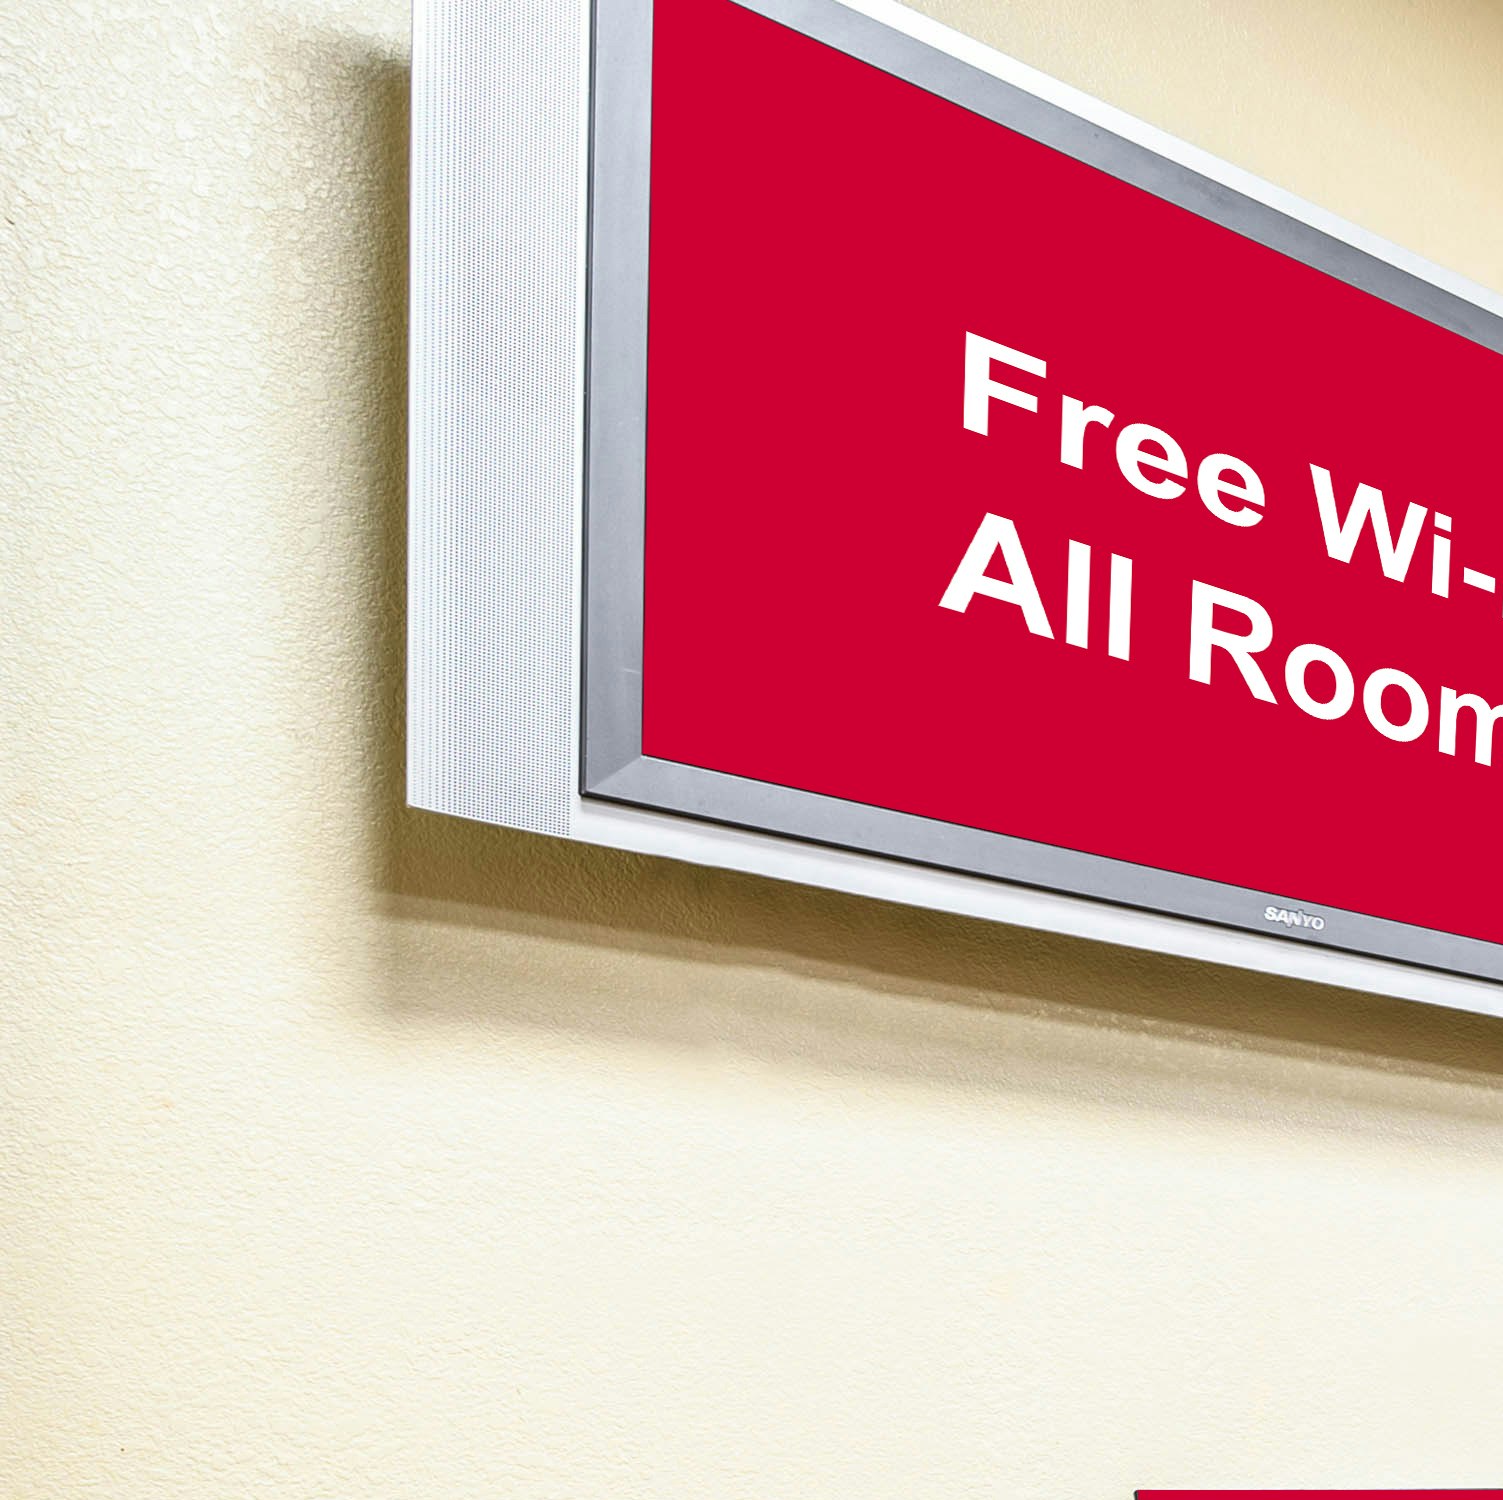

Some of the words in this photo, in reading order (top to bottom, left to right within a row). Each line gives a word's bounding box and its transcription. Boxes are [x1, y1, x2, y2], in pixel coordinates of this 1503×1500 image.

[963, 330, 1266, 529] Free
[937, 512, 1133, 662] All
[1263, 905, 1326, 931] SANYO
